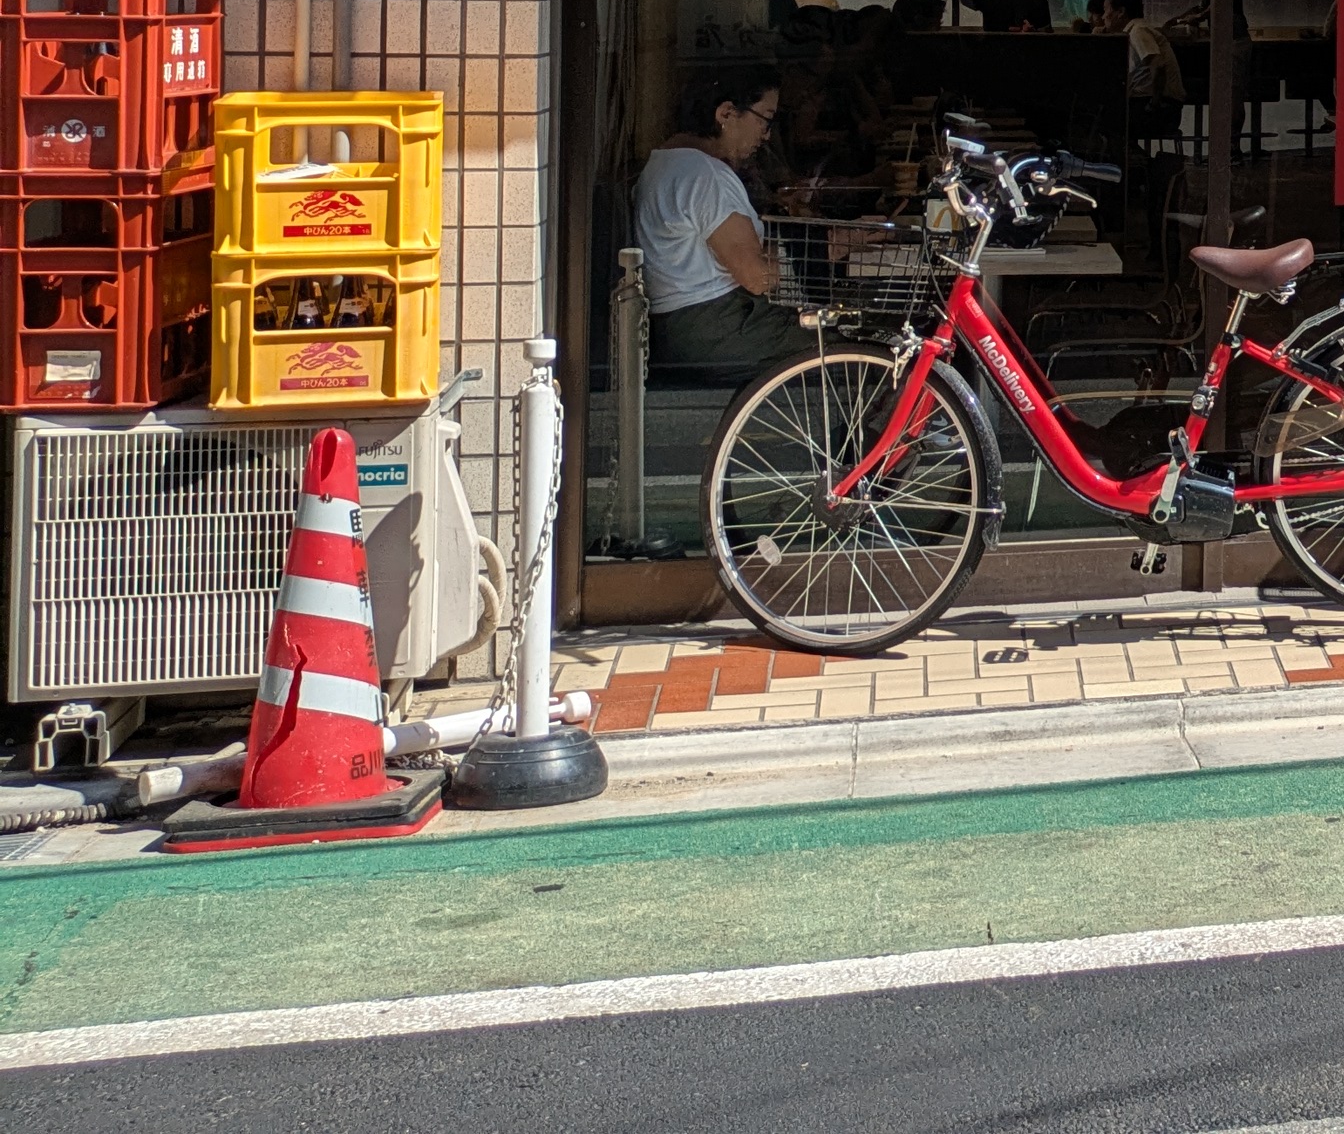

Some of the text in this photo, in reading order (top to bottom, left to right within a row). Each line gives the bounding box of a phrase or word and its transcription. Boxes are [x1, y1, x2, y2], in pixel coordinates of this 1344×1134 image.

[303, 225, 351, 236] 中びん20本
[979, 335, 1036, 414] McDelivery
[301, 377, 349, 388] 中びん20本
[358, 440, 403, 459] FUJITSU
